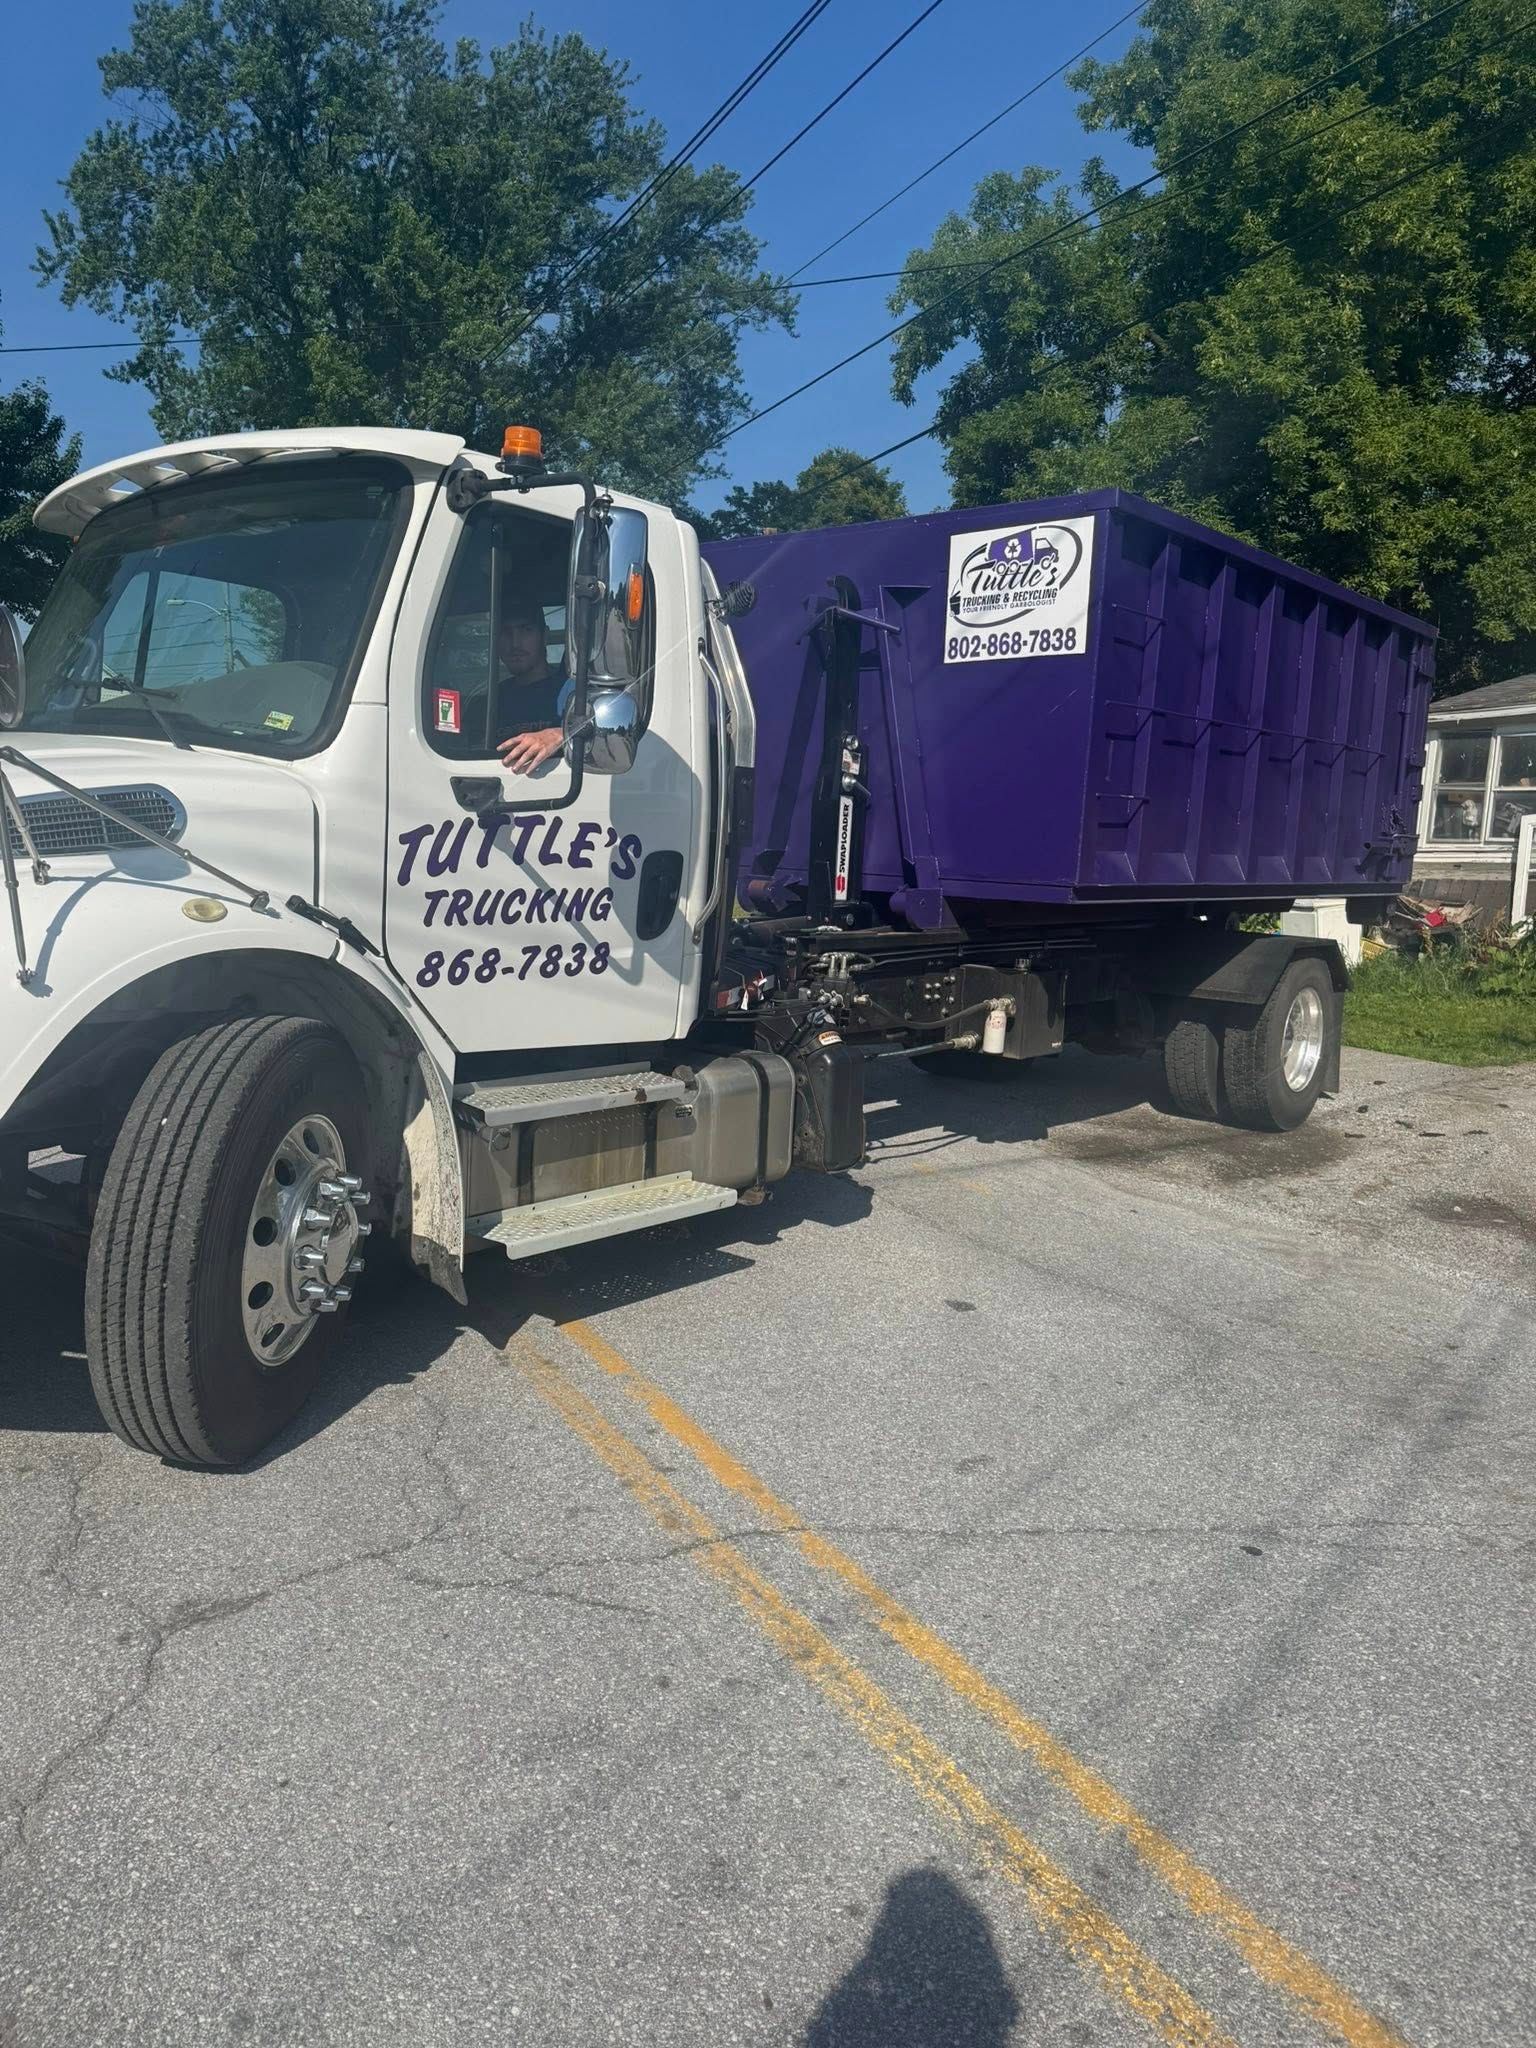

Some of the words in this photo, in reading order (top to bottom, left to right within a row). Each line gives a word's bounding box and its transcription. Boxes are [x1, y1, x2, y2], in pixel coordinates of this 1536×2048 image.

[967, 554, 1059, 594] Tuttle's
[962, 594, 1001, 607] TRUCKING
[1003, 593, 1010, 603] &
[1012, 588, 1058, 602] RECYCLING
[979, 604, 1007, 612] FRIENDLY
[948, 627, 1077, 660] 802-868-7838
[397, 814, 642, 886] TUTTLE'S
[839, 804, 850, 873] SWAPLOADER
[423, 887, 614, 927] TRUCKING
[416, 941, 610, 988] 868-7838
